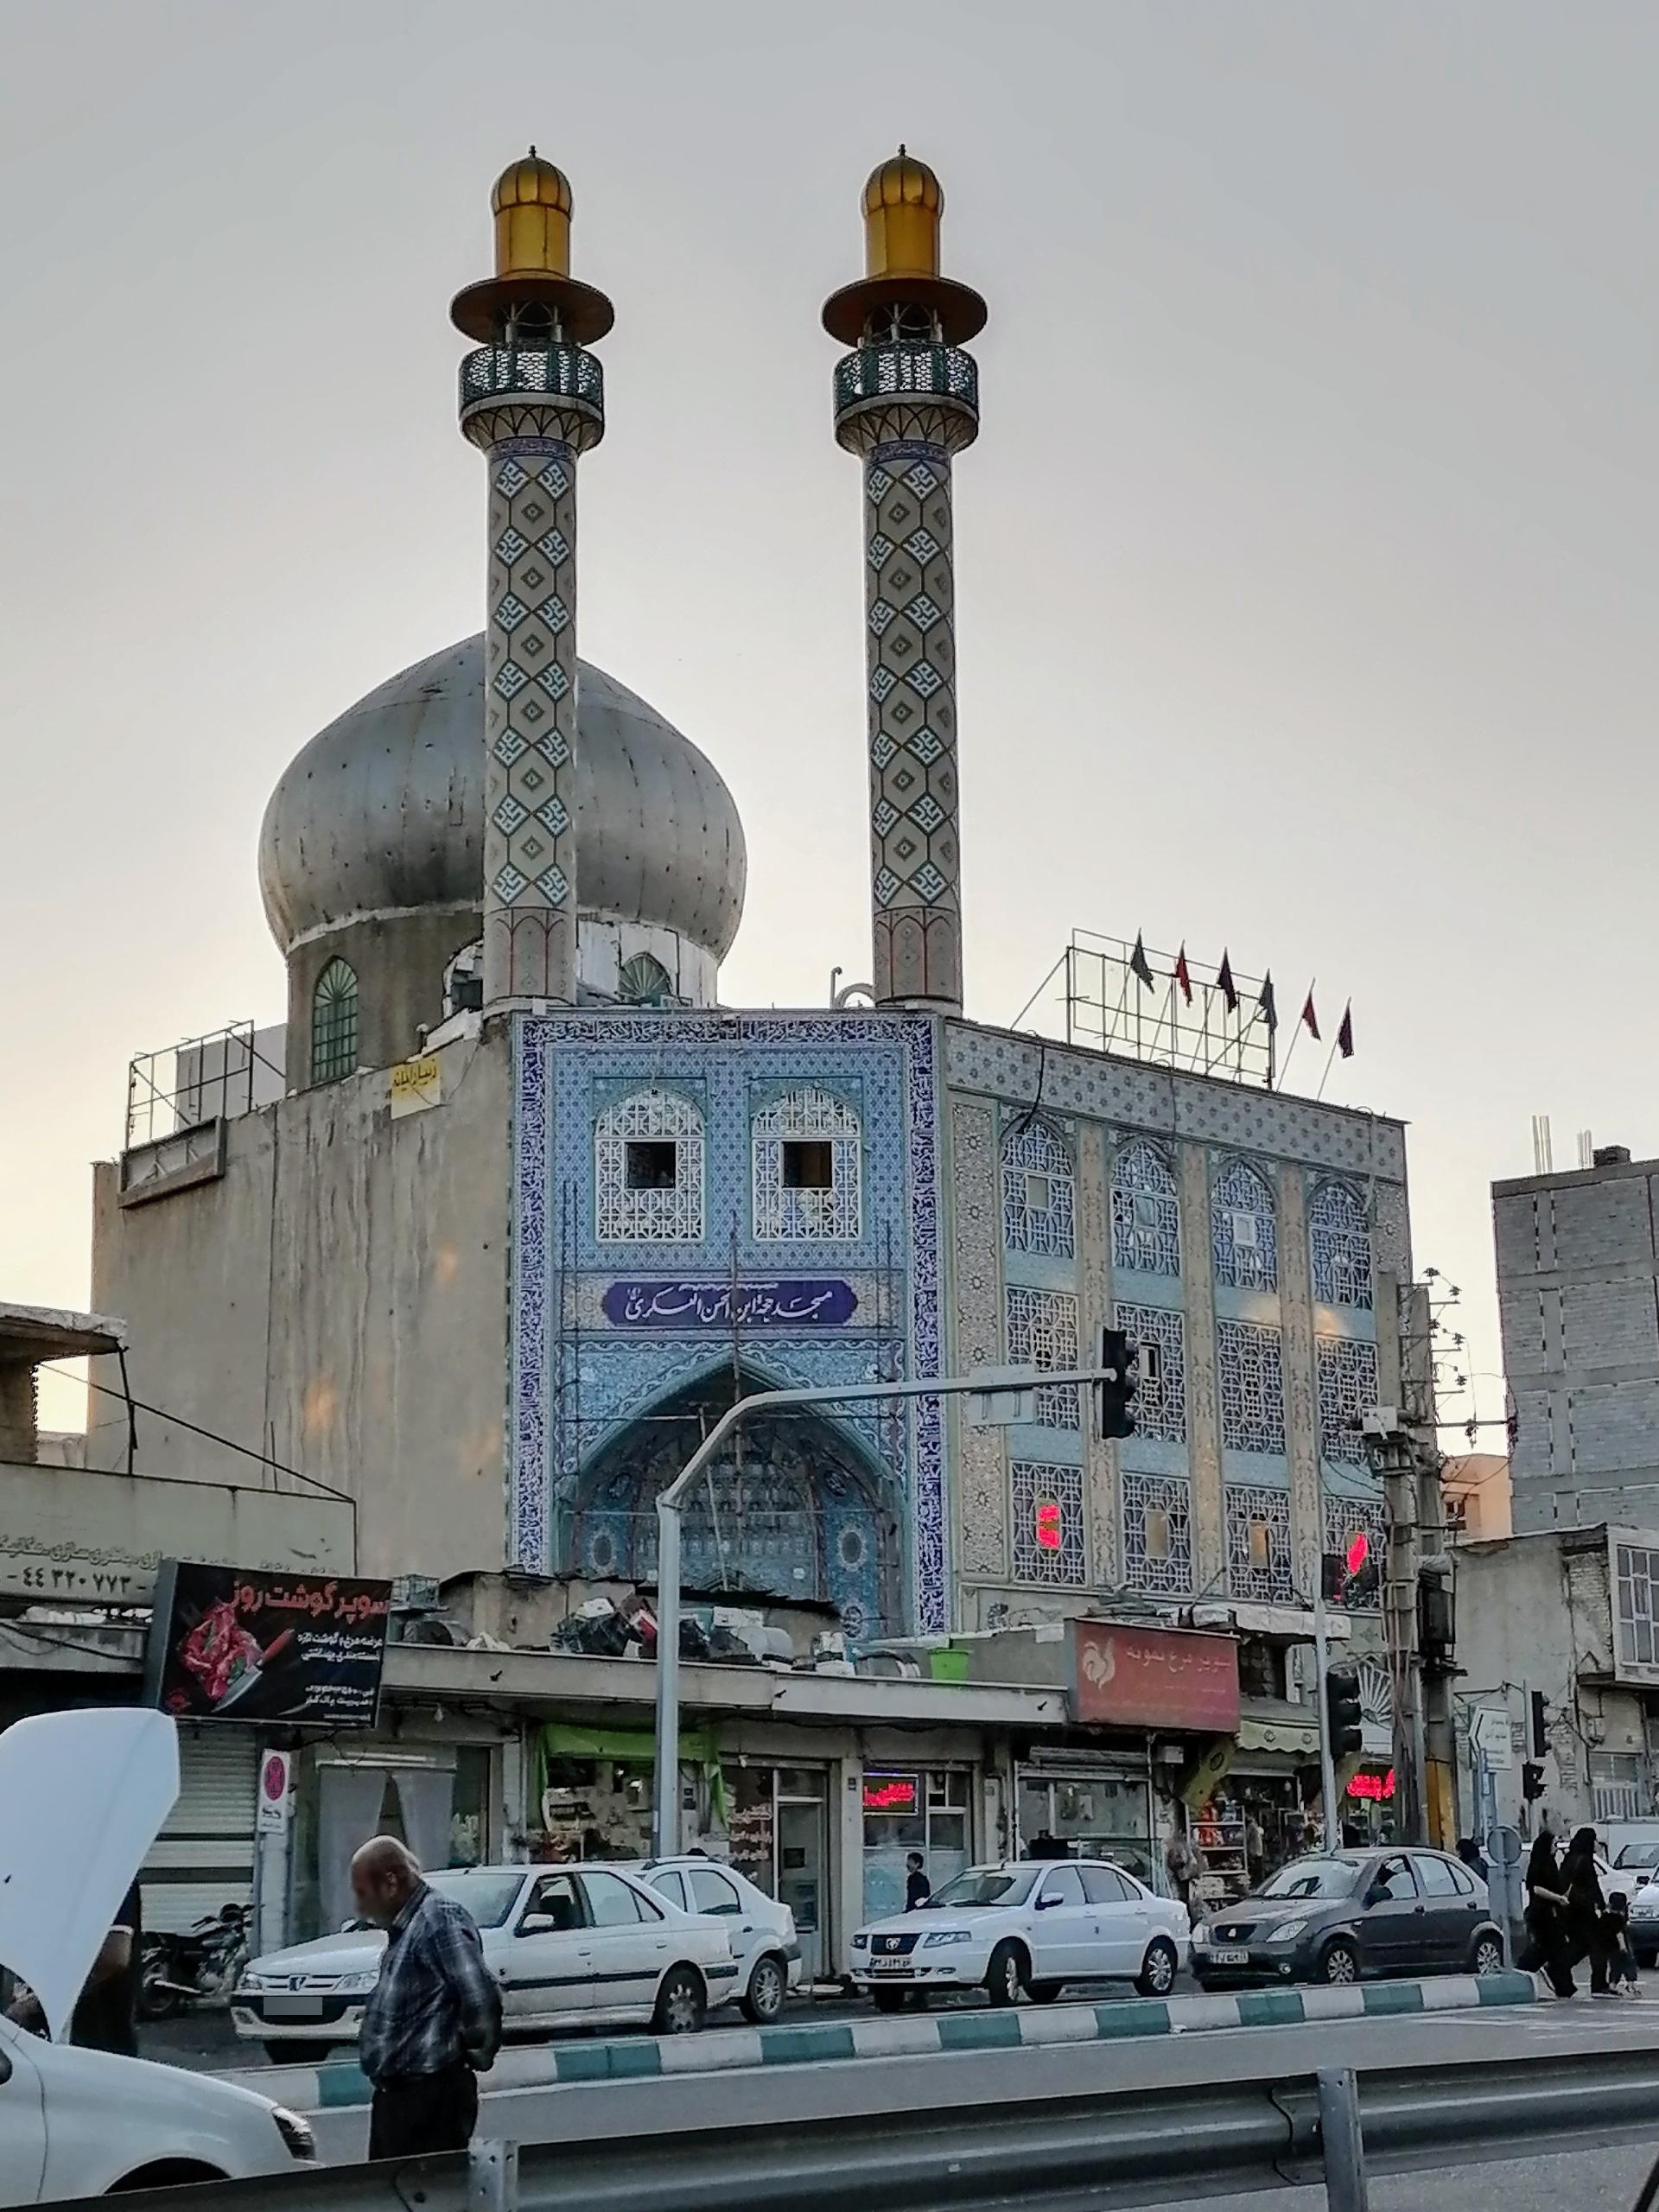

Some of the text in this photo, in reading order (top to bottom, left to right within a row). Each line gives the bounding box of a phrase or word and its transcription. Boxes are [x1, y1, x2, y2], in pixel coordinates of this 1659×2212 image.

[771, 1291, 833, 1319] مسجد
[227, 1580, 389, 1625] سوپر گوشت روز
